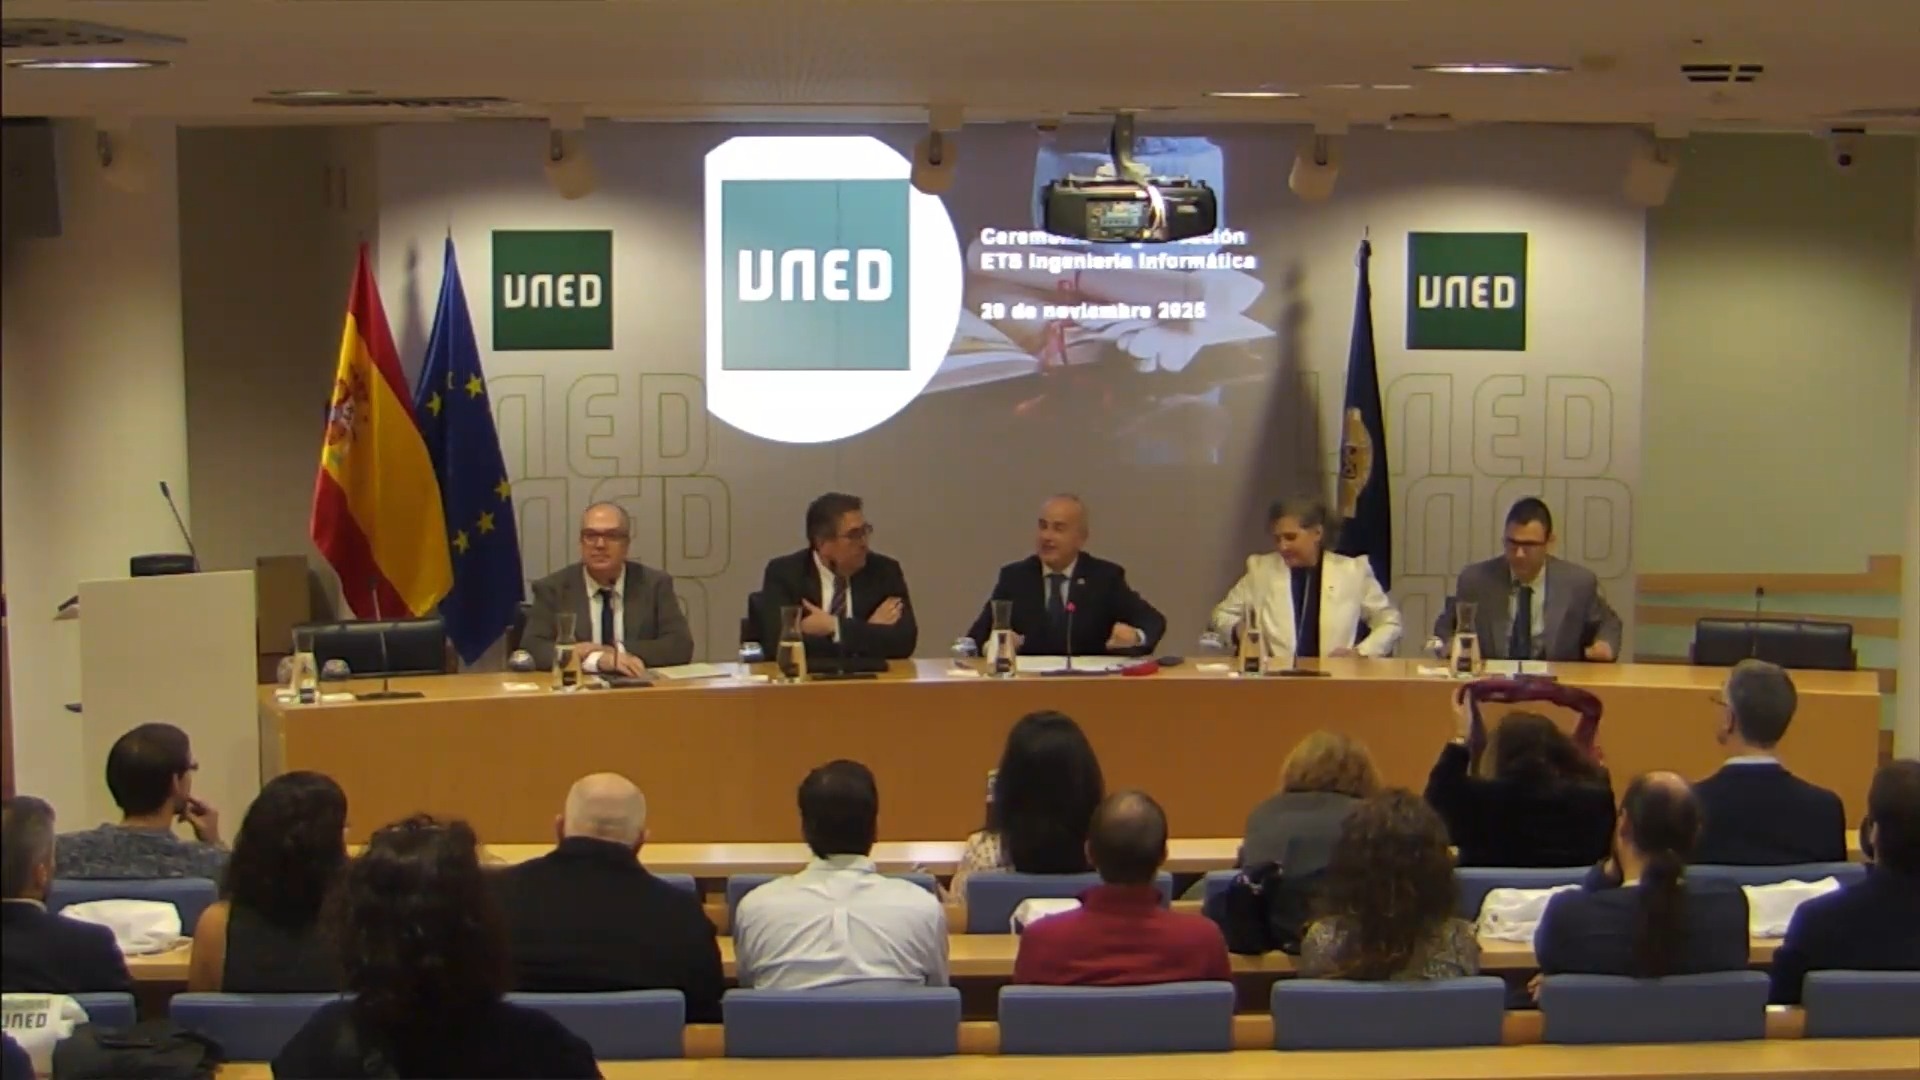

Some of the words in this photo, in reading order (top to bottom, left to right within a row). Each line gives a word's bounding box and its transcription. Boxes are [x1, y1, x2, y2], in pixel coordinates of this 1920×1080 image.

[738, 248, 892, 301] UNED
[981, 252, 1023, 270] ETS
[503, 273, 602, 308] UNED
[1418, 275, 1516, 309] UNED
[981, 302, 1005, 320] 20
[1011, 302, 1037, 319] de
[1043, 302, 1151, 319] noviembre
